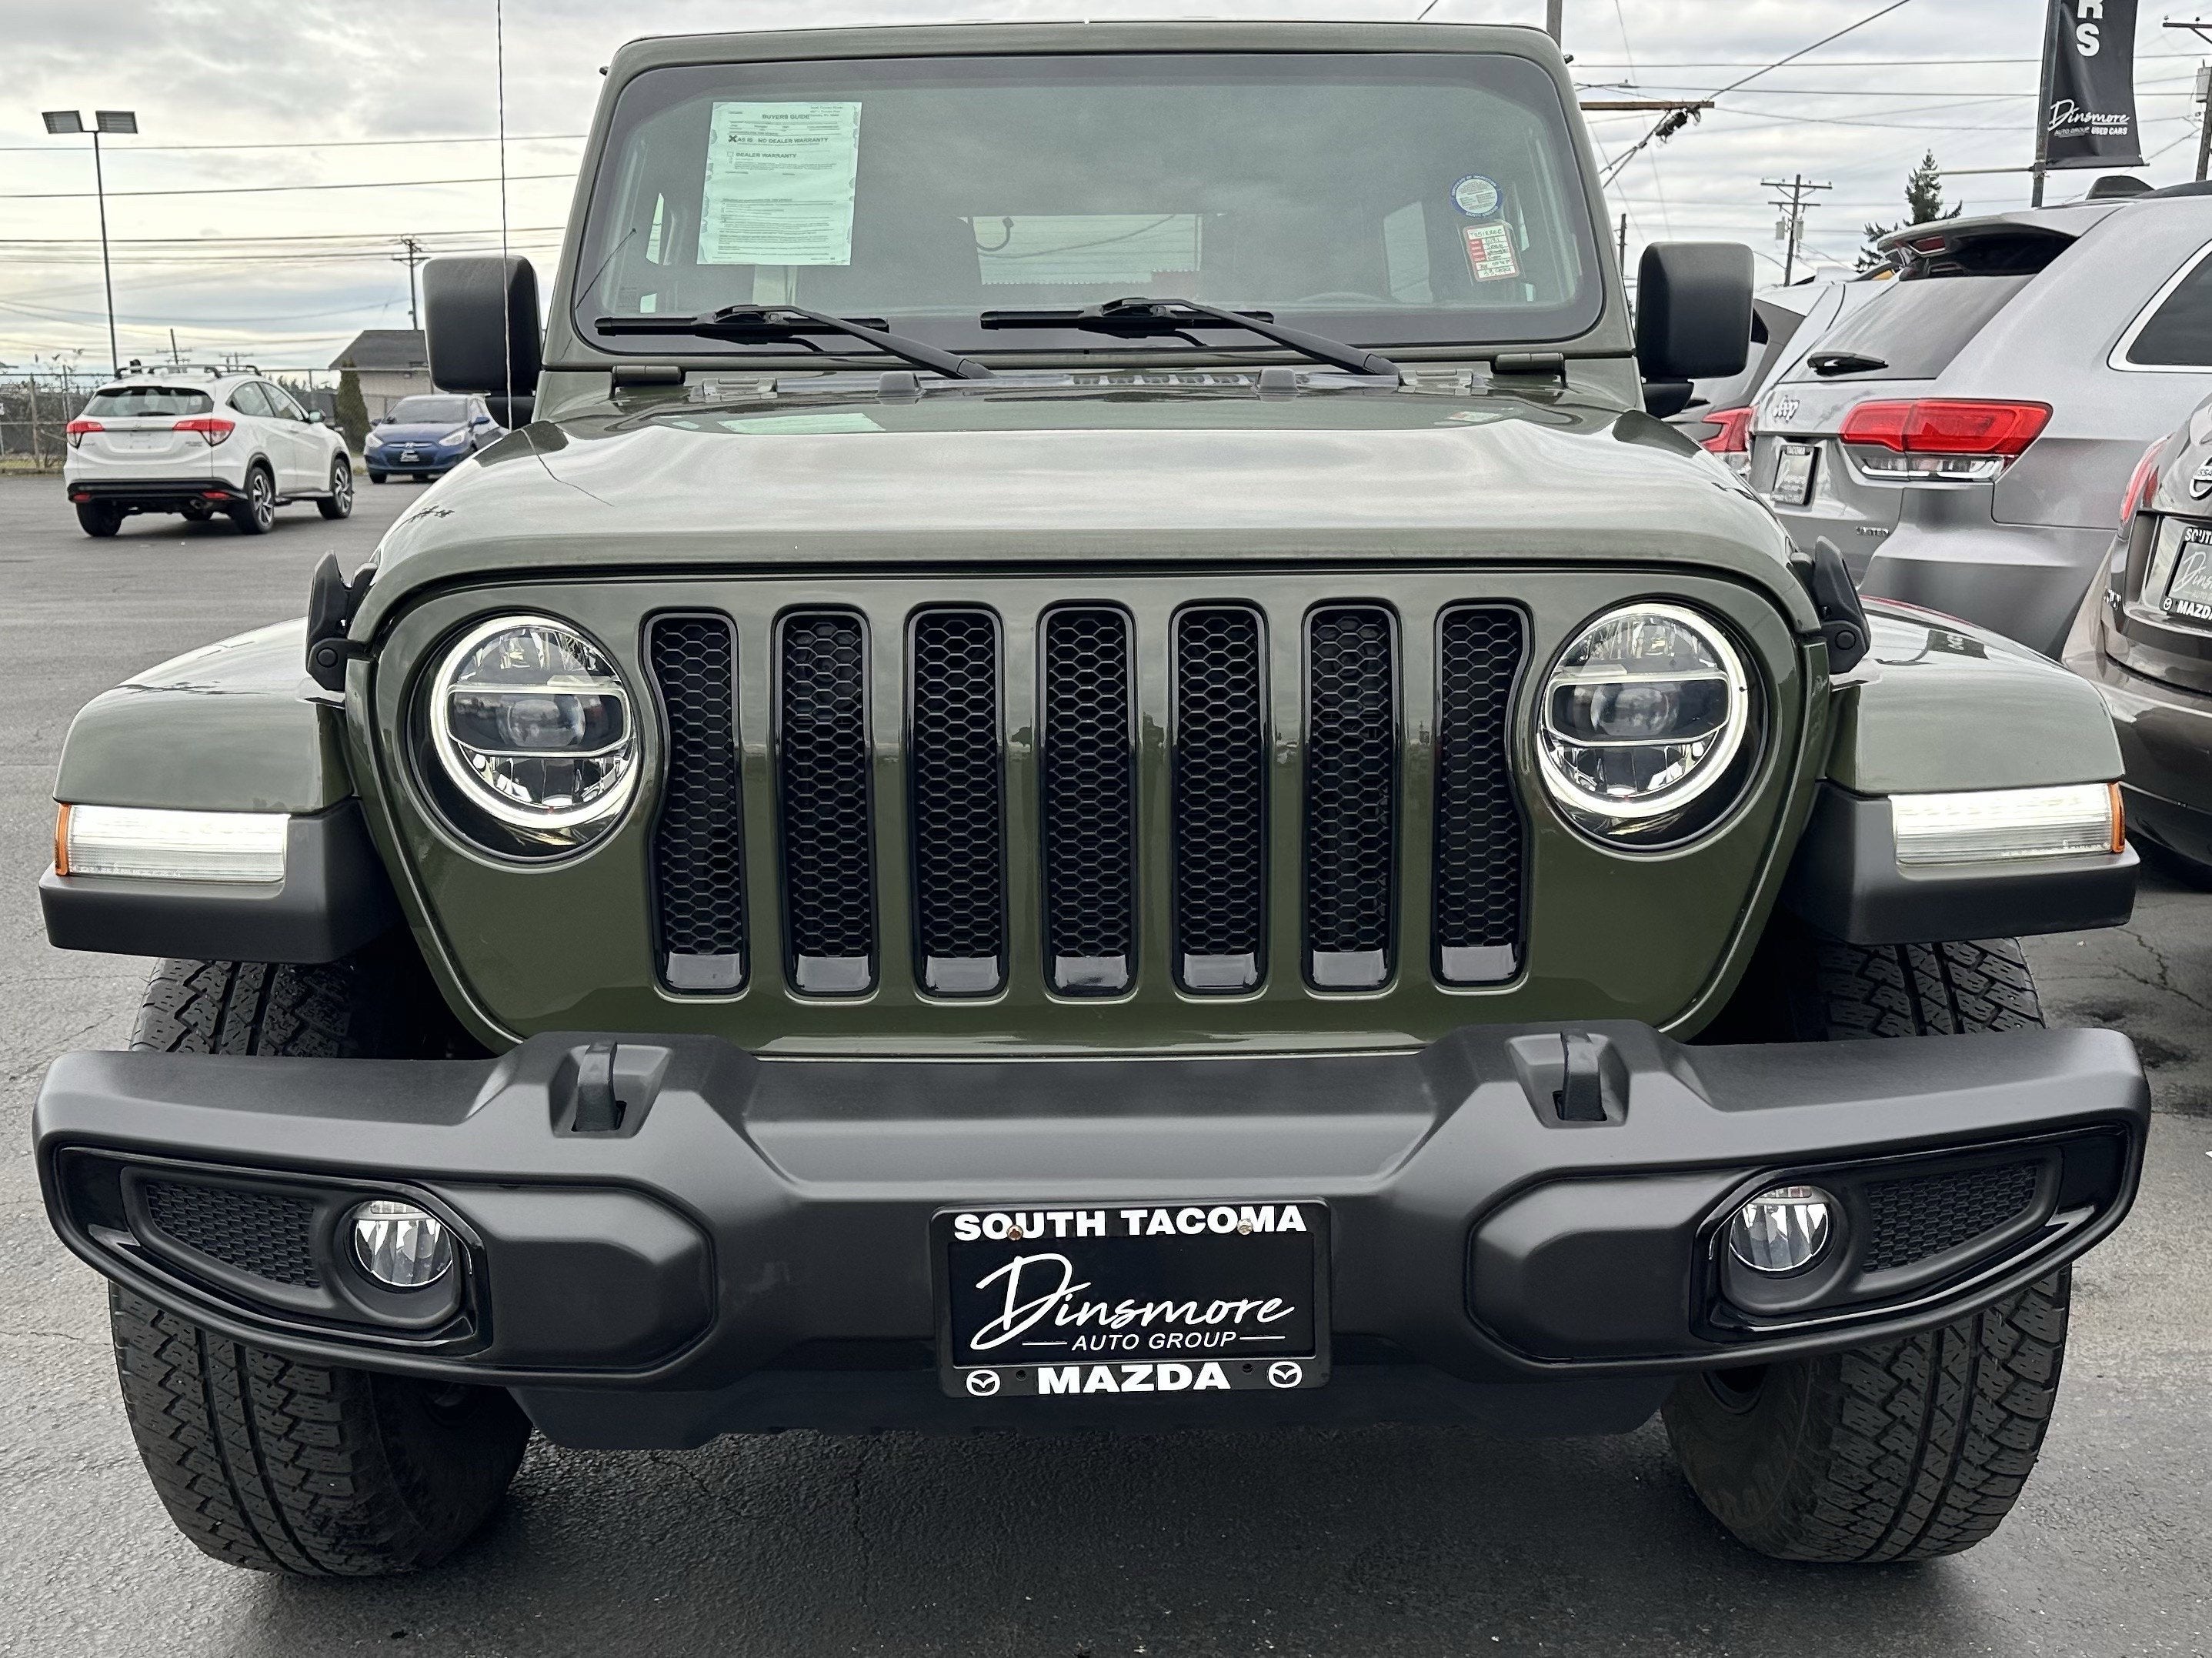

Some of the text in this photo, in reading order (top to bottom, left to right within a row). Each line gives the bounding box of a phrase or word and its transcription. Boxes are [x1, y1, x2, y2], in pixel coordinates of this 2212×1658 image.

[2047, 98, 2130, 132] Dinsmore
[2090, 126, 2108, 135] USED
[2108, 126, 2128, 135] CARS
[2185, 527, 2212, 545] SOUT
[2176, 599, 2212, 621] MAZD
[953, 1204, 1307, 1242] SOUTH TACOMA
[969, 1253, 1296, 1351] Dinsmore
[1071, 1330, 1237, 1352] AUTO GROUP
[1037, 1362, 1232, 1396] MAZDA
